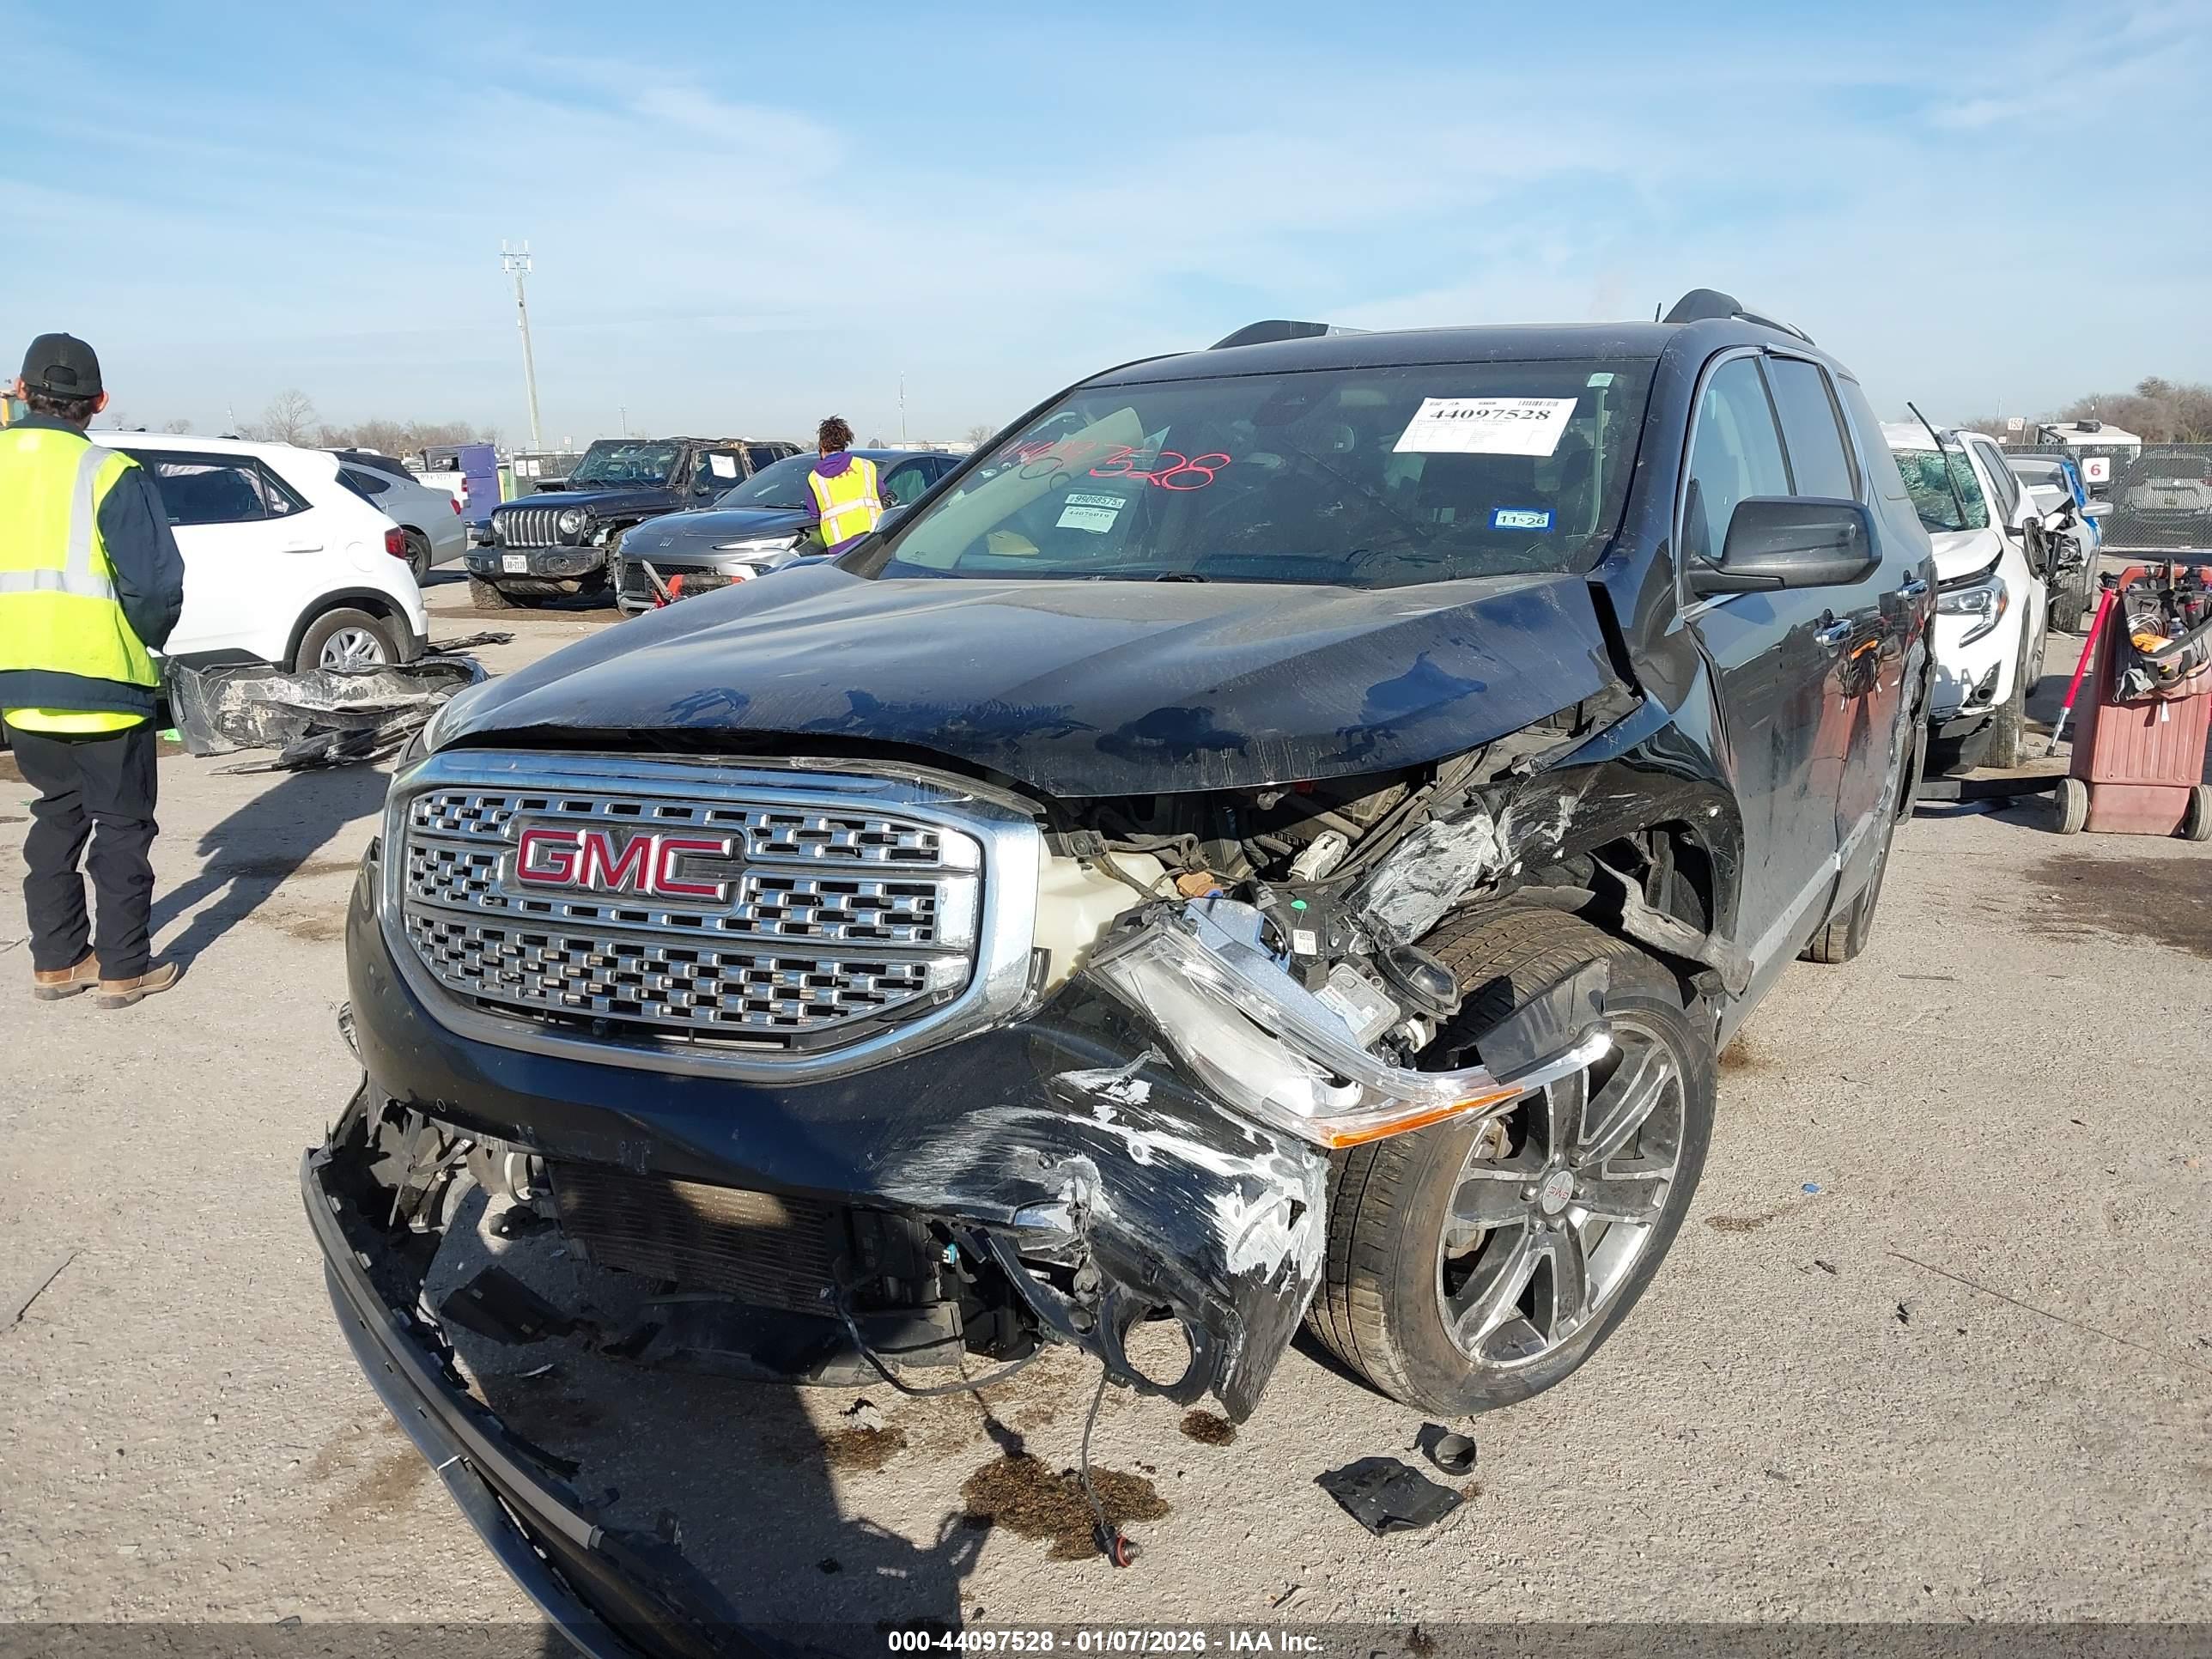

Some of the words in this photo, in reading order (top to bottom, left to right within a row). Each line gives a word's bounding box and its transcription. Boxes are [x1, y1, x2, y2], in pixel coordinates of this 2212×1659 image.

[1430, 410, 1551, 420] 44097528
[2090, 464, 2101, 476] 6
[516, 826, 732, 902] GMC
[1547, 1185, 1570, 1201] GMC
